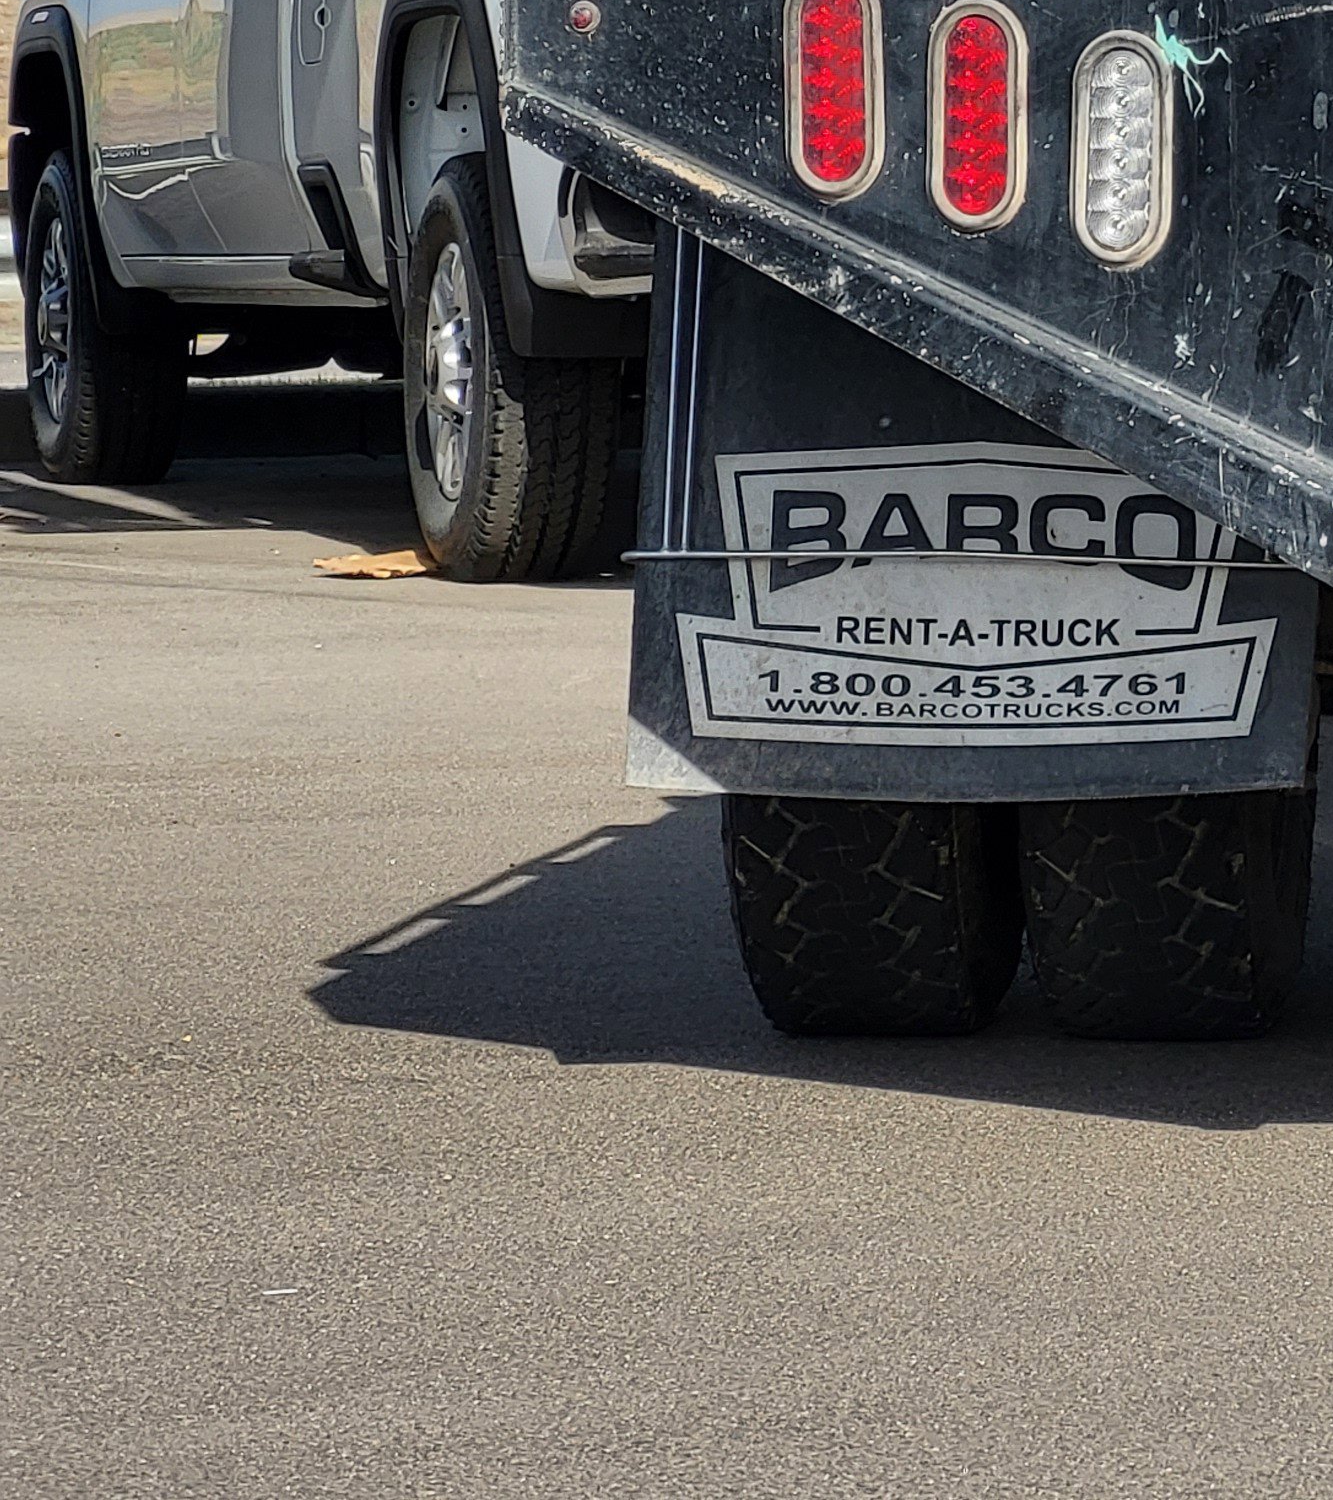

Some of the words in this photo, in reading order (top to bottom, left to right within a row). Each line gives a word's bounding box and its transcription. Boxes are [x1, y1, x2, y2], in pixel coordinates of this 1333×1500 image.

[769, 489, 1197, 591] BARCO
[835, 616, 1121, 648] RENT-A-TRUCK
[758, 670, 1190, 699] 1.800.453.4761
[765, 698, 1181, 719] WWW.BARCOTRUCKS.COM
